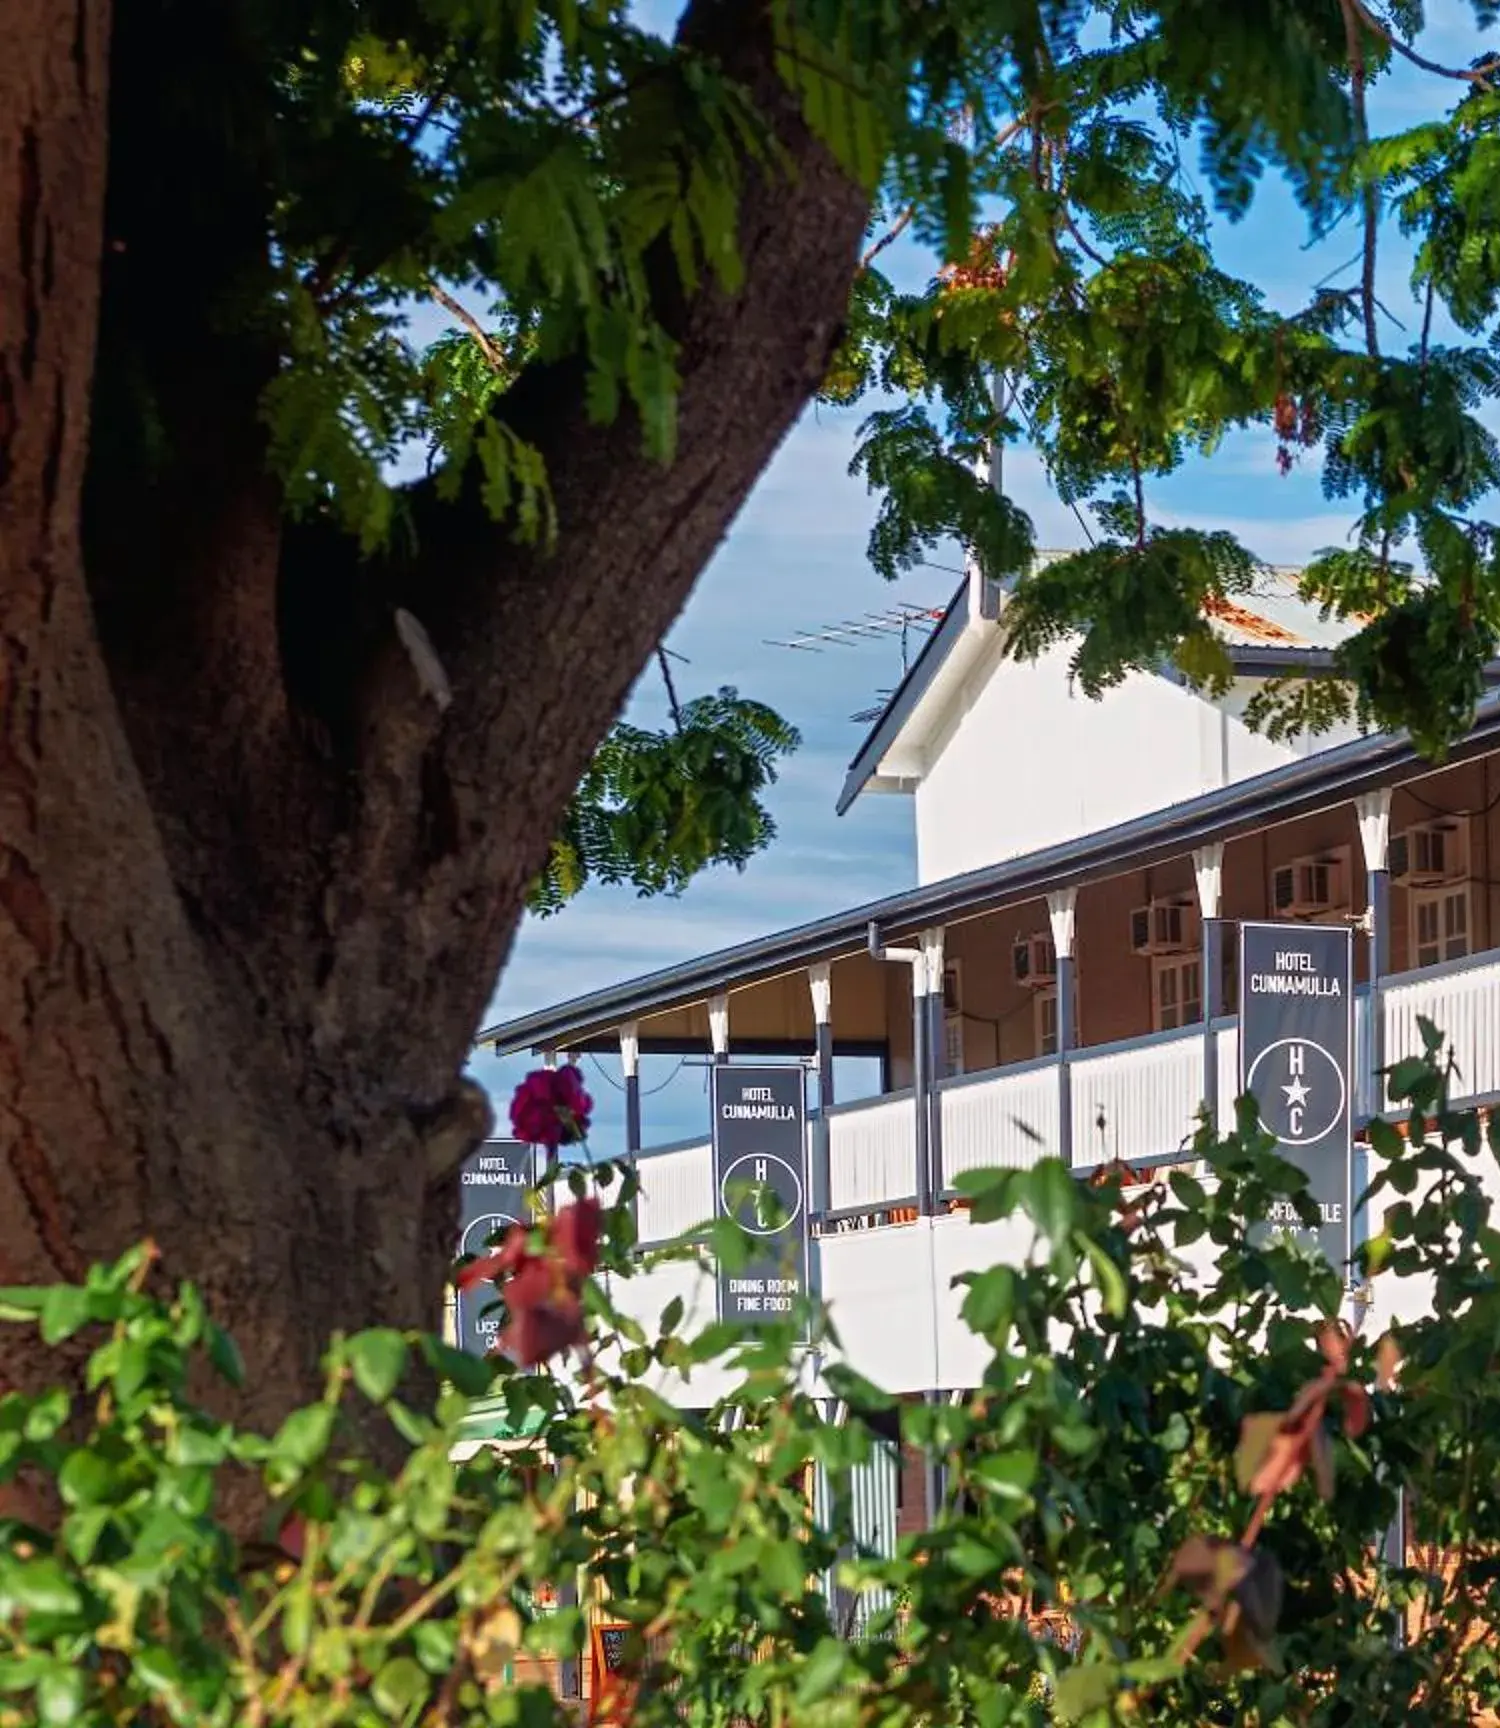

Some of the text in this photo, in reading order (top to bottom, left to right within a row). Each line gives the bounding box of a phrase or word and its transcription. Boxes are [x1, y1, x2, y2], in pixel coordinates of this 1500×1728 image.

[1276, 952, 1316, 971] HOTEL
[1251, 975, 1340, 996] CUNNAMULLA
[1289, 1046, 1304, 1074] H
[742, 1088, 774, 1102] HOTEL
[722, 1104, 795, 1120] CUNNAMULLA
[1290, 1107, 1303, 1135] C
[480, 1157, 508, 1170] HOTEL
[755, 1160, 767, 1181] H
[462, 1172, 526, 1185] CUNNAMULLA
[729, 1279, 764, 1293] DINING
[737, 1297, 761, 1312] FINE
